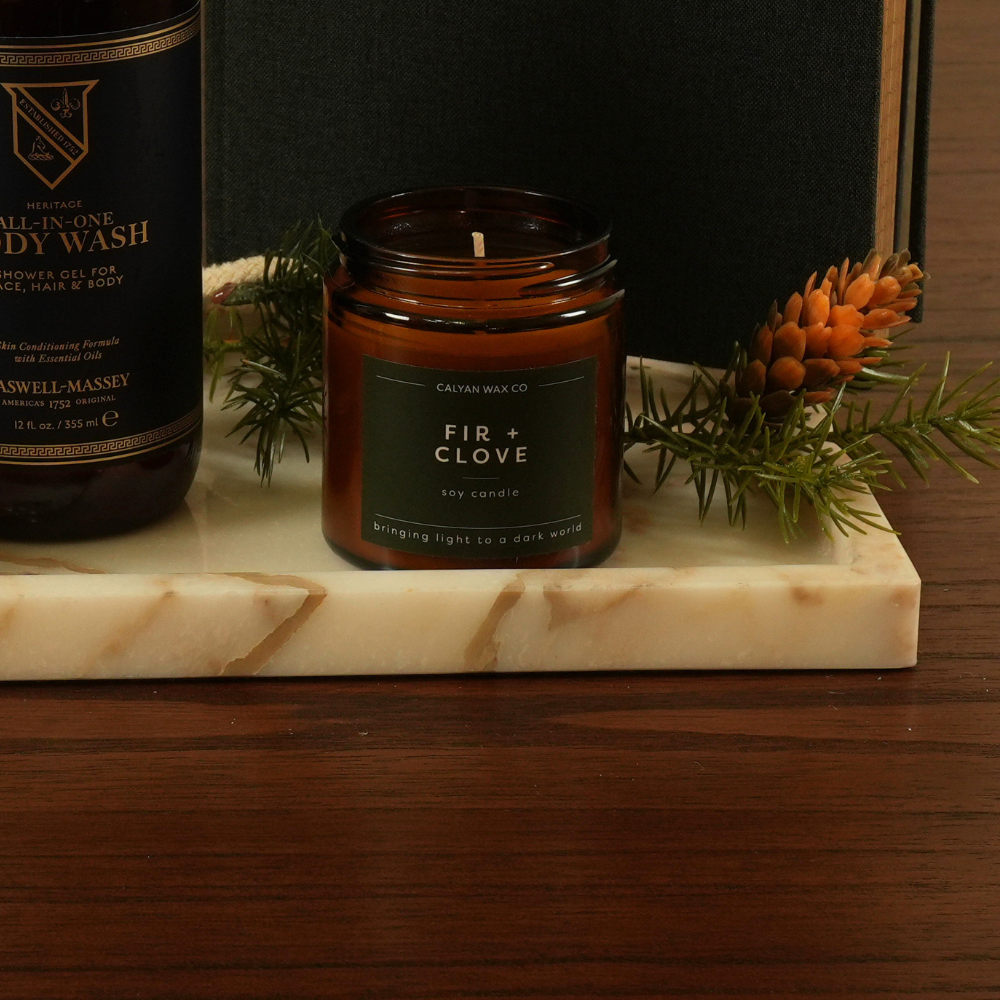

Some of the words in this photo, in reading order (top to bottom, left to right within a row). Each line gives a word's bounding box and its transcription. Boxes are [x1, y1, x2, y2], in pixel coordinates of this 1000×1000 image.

[19, 99, 64, 142] ESTABLISHED
[63, 140, 79, 156] 1752
[27, 200, 83, 210] HERITAGE
[59, 220, 149, 255] WASH
[60, 270, 86, 280] GEL
[91, 265, 116, 277] FOR
[31, 282, 66, 292] HAIR
[71, 280, 82, 290] &
[88, 275, 124, 290] BODY
[19, 342, 80, 352] Conditioning
[82, 336, 120, 349] Formula
[14, 354, 36, 364] with
[39, 353, 81, 364] Essential
[83, 350, 102, 361] Oils
[436, 383, 480, 394] CALYAN
[482, 385, 509, 394] WAX
[511, 383, 528, 393] CO
[49, 400, 71, 410] 1752
[76, 395, 116, 406] ORIGINAL
[14, 420, 24, 430] 12
[65, 419, 83, 429] 355
[86, 417, 99, 428] ml
[445, 424, 491, 442] FIR
[507, 427, 519, 440] +
[434, 446, 528, 465] CLOVE
[441, 488, 465, 500] soy
[471, 487, 520, 499] candle
[373, 520, 429, 543] bringing
[436, 532, 471, 546] light
[477, 535, 492, 545] to
[499, 536, 507, 545] a
[513, 531, 545, 543] dark
[550, 521, 583, 539] world
